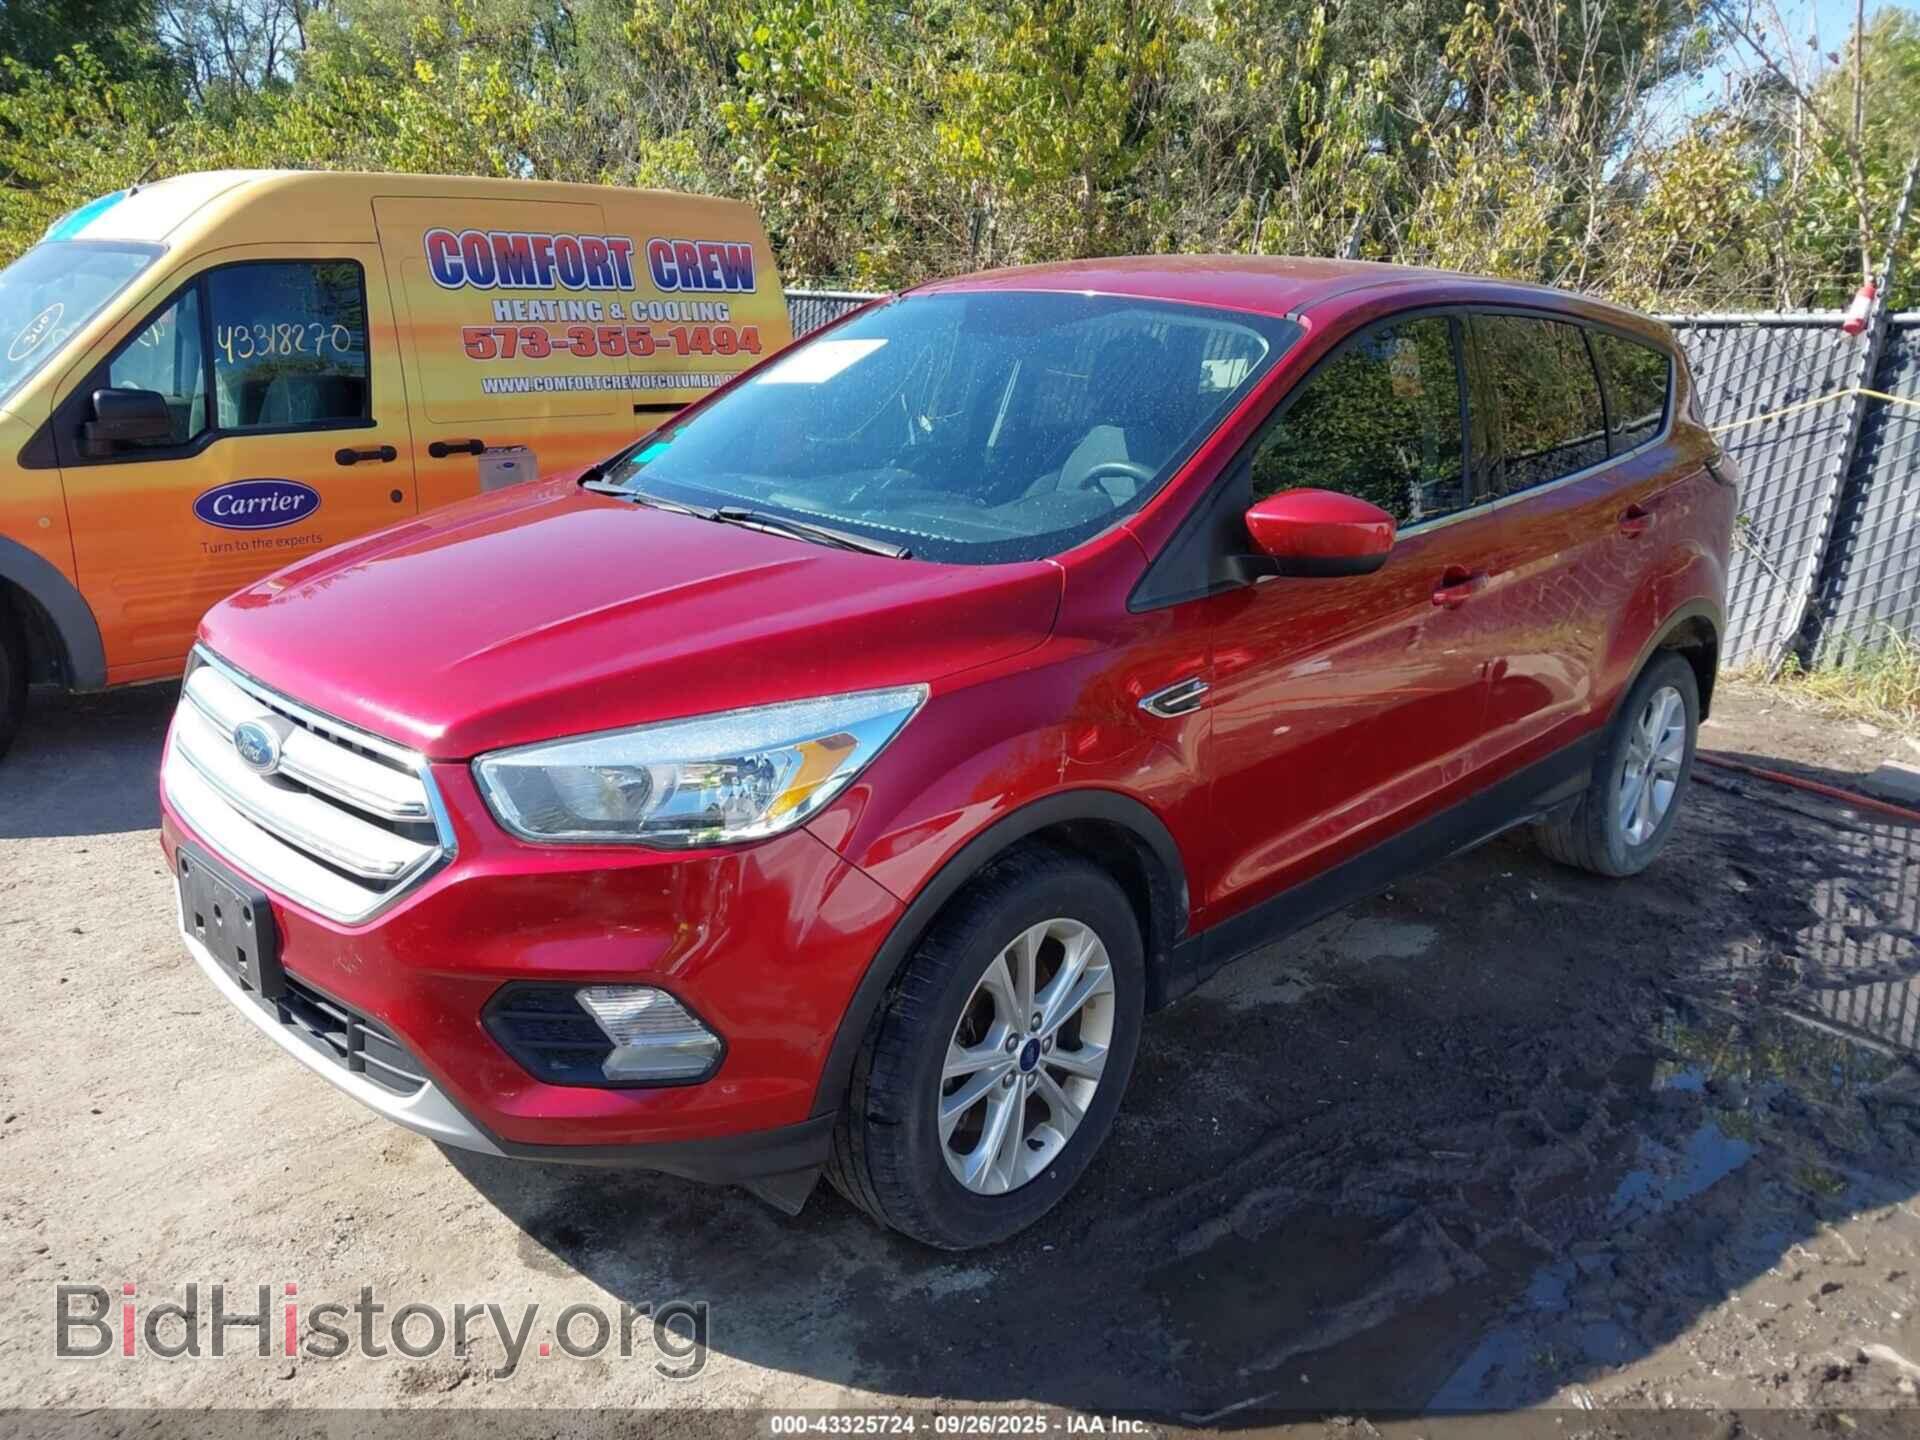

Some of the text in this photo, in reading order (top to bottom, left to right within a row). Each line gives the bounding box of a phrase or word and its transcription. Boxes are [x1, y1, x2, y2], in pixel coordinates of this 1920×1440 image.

[424, 228, 757, 294] COMFORT CREW
[493, 300, 730, 322] HEATING & COOLING
[218, 323, 350, 364] 43318270
[462, 325, 762, 359] 573-355-1494
[213, 492, 305, 516] Carrier
[201, 533, 323, 554] Turn to the experts
